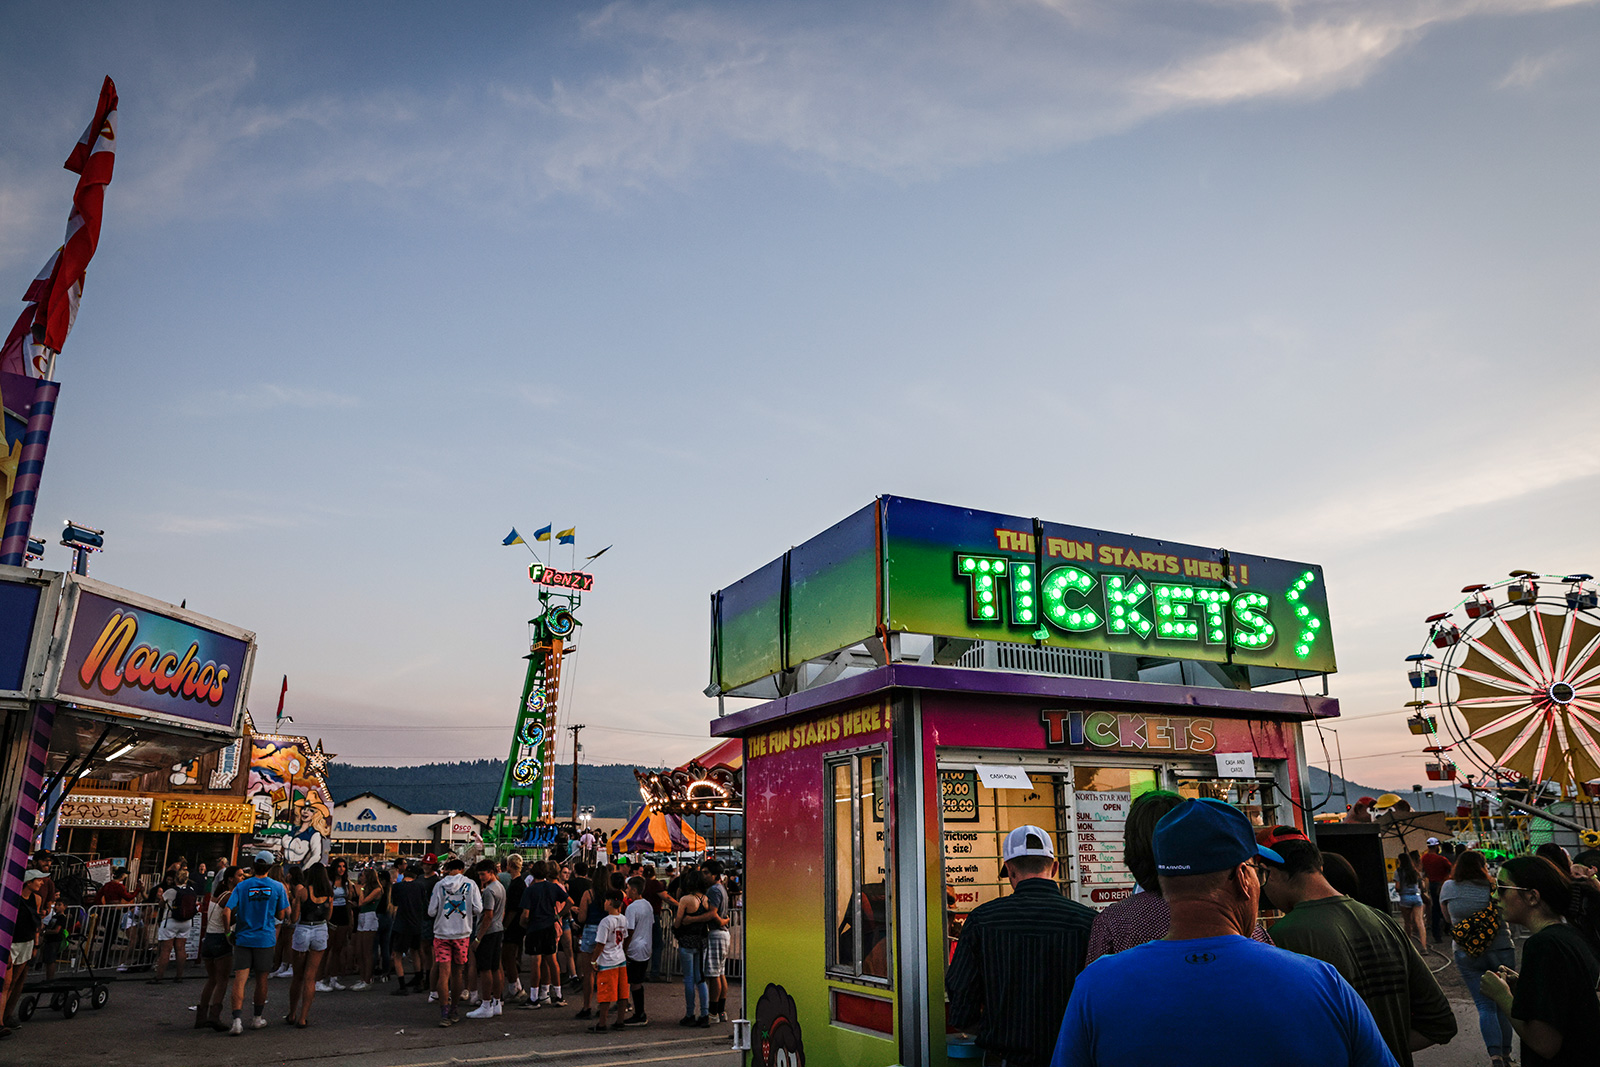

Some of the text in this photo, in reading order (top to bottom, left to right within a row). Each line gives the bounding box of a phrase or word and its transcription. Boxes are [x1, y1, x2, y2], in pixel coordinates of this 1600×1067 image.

[1047, 536, 1094, 561] FUN
[1097, 544, 1181, 576] STARTS
[960, 554, 1274, 651] TICKETS
[78, 607, 230, 708] Nachos
[748, 735, 767, 758] THE
[769, 726, 790, 754] FUN
[792, 715, 841, 749] STARTS
[1041, 709, 1216, 753] TICKETS
[1099, 793, 1115, 802] STAR
[1103, 803, 1121, 811] OPEN
[171, 808, 243, 827] Howdy Y'all!
[1076, 812, 1092, 820] SUN.
[333, 821, 398, 833] Albertsons
[453, 823, 471, 832] Osco
[1077, 823, 1094, 831] MON.
[1078, 833, 1096, 841] TUES.
[964, 865, 978, 873] with
[1098, 889, 1132, 901] NO REFU
